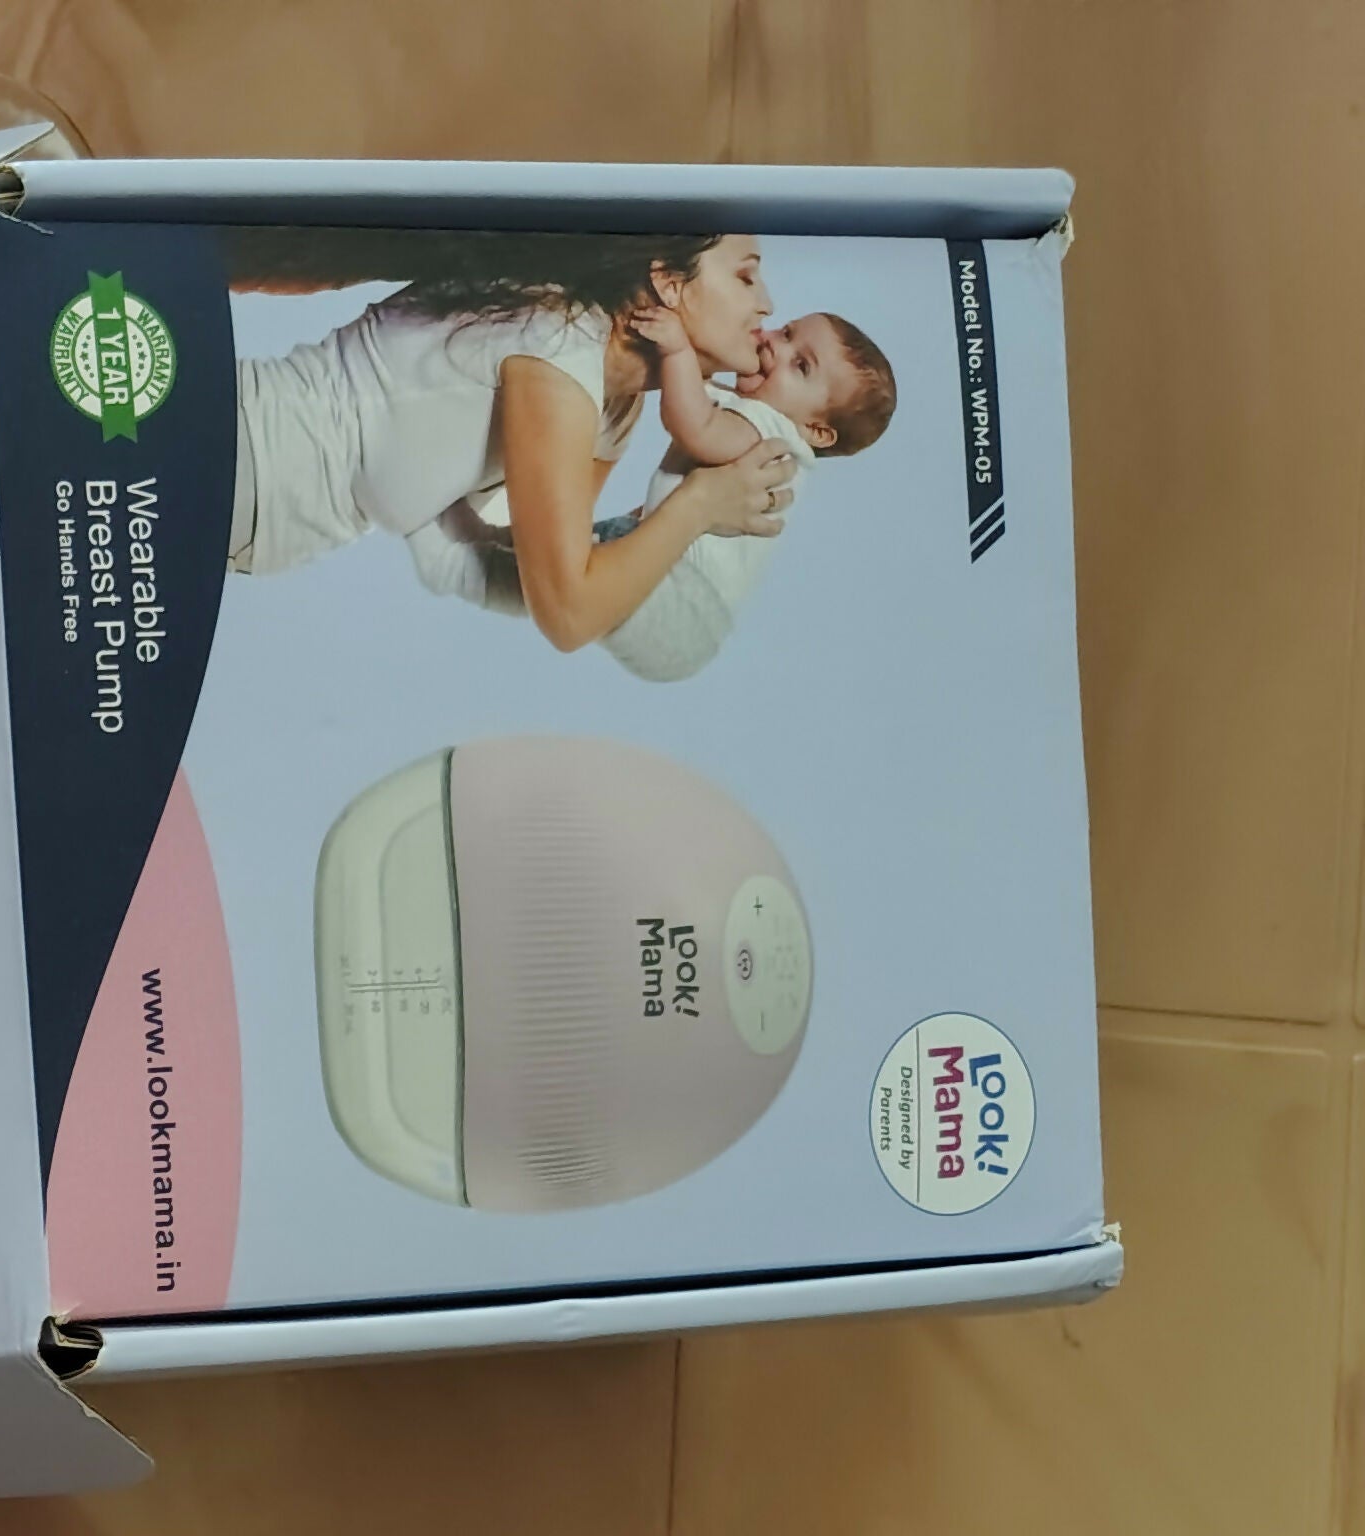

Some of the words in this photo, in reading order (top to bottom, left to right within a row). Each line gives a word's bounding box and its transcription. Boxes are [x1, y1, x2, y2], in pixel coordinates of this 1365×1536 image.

[96, 306, 121, 319] 1
[958, 259, 982, 332] Model
[54, 310, 89, 404] WARRANTY
[98, 331, 128, 404] YEAR
[136, 307, 170, 405] WARRANTY
[966, 337, 984, 383] No.:
[970, 387, 992, 483] WPM-05
[55, 479, 73, 512] Go
[57, 518, 78, 588] Hands
[84, 479, 122, 607] Breast
[125, 476, 166, 662] Wearable
[62, 594, 80, 642] Free
[90, 620, 126, 733] Pump
[635, 917, 665, 1017] Mama
[668, 924, 700, 1018] Look!
[141, 967, 181, 1292] www.lookmama.in
[879, 1086, 892, 1151] Parents
[897, 1065, 914, 1145] Designed
[927, 1045, 965, 1179] Mama
[968, 1052, 1009, 1175] Look!
[897, 1148, 914, 1169] by
